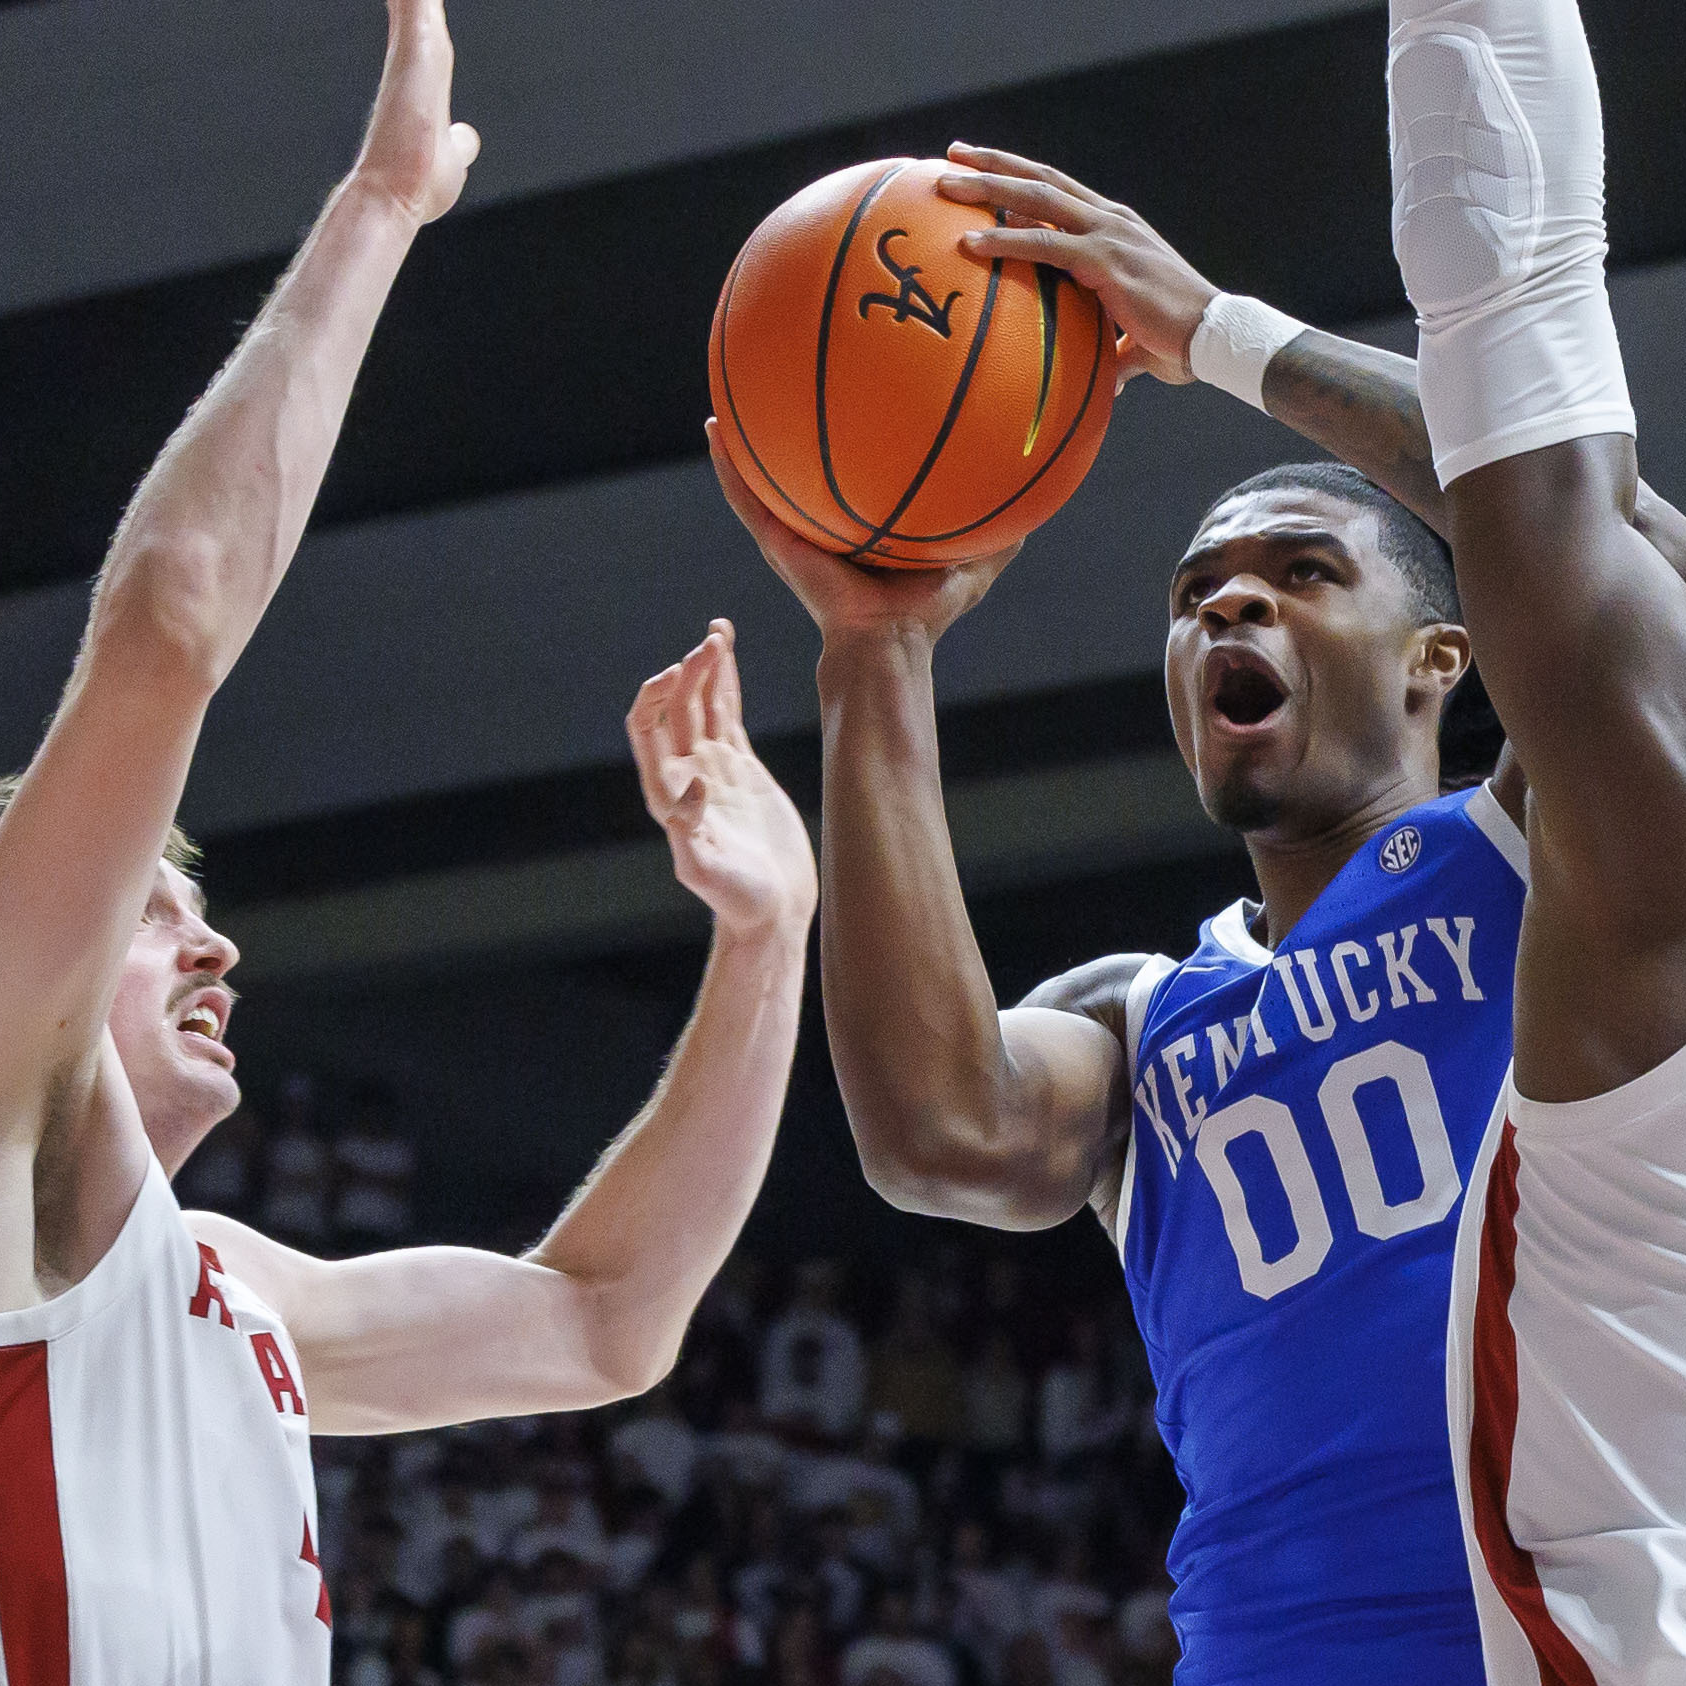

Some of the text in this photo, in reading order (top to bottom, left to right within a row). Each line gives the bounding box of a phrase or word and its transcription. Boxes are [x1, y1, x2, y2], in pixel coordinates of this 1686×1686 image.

[859, 228, 963, 340] A
[1383, 830, 1418, 870] SEC
[1194, 1039, 1463, 1300] 00
